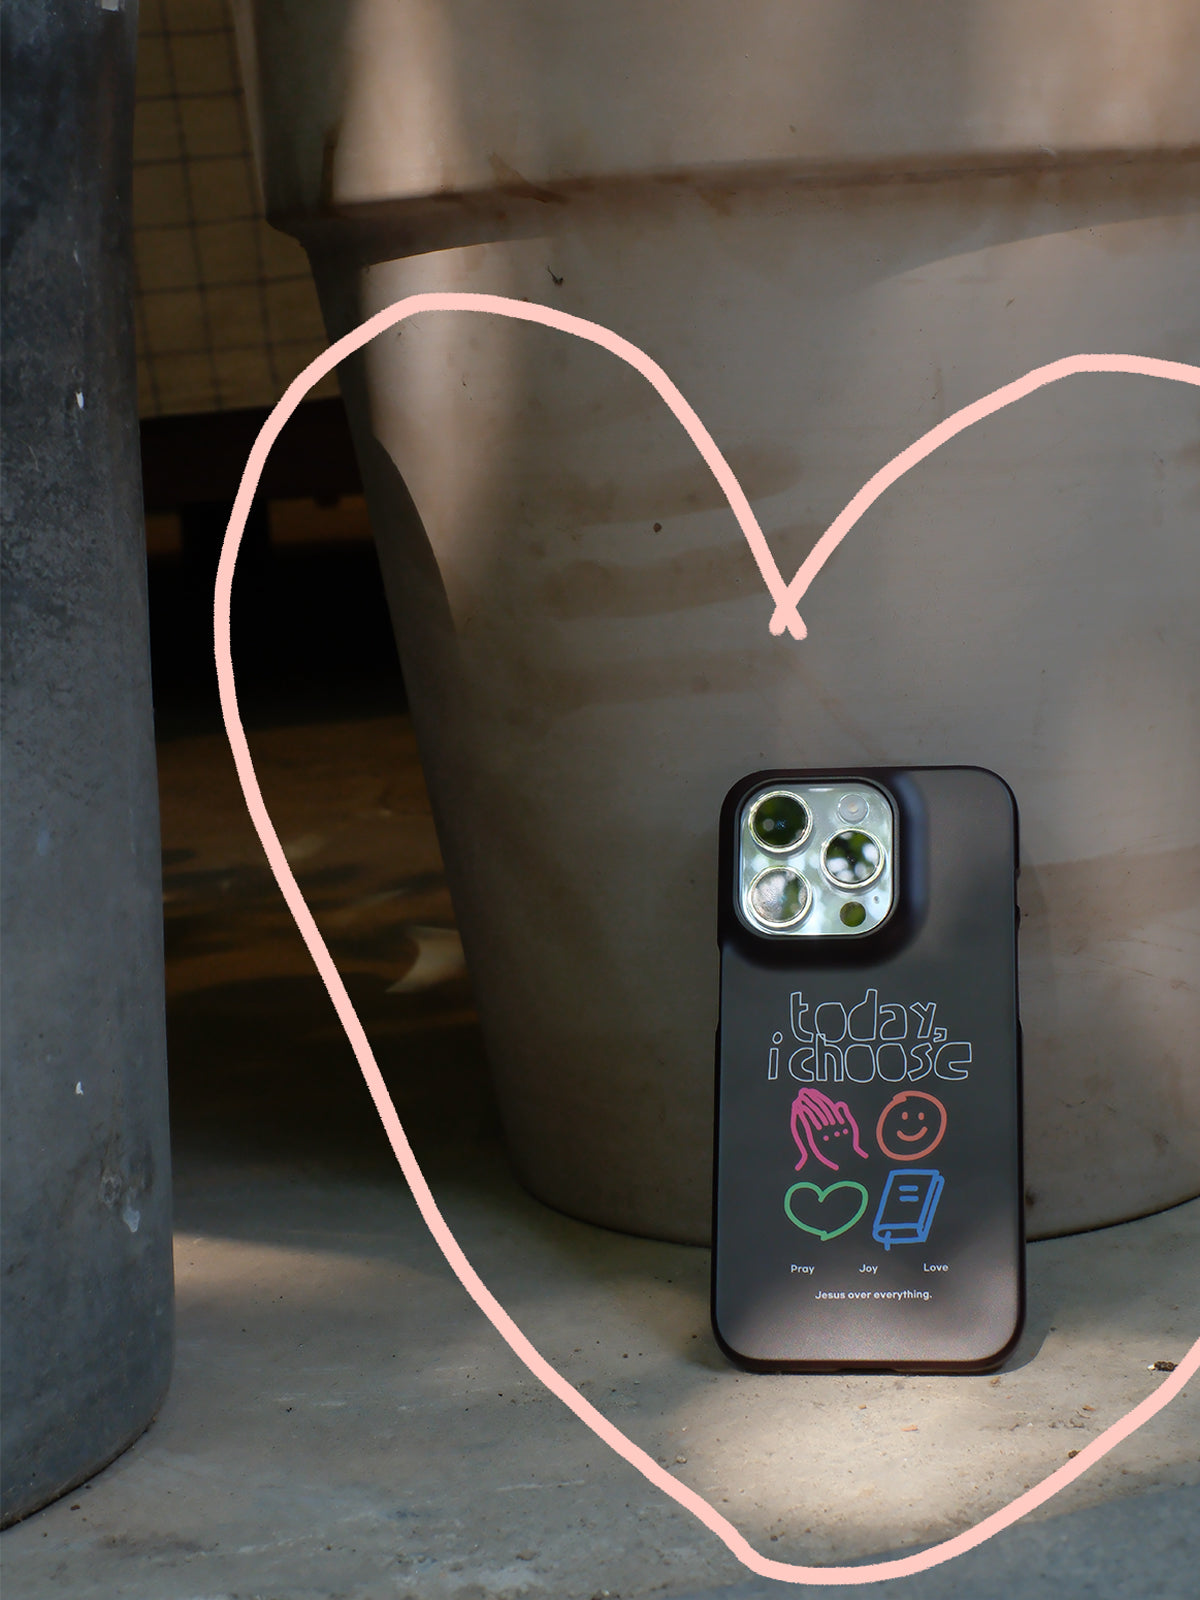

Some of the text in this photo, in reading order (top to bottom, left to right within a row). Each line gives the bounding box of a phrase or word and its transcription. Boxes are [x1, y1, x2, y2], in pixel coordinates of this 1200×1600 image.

[790, 988, 948, 1043] today,
[768, 1031, 973, 1083] i choose
[790, 1263, 949, 1275] Pray Joy Love
[814, 1289, 933, 1301] Jesus over everything.
